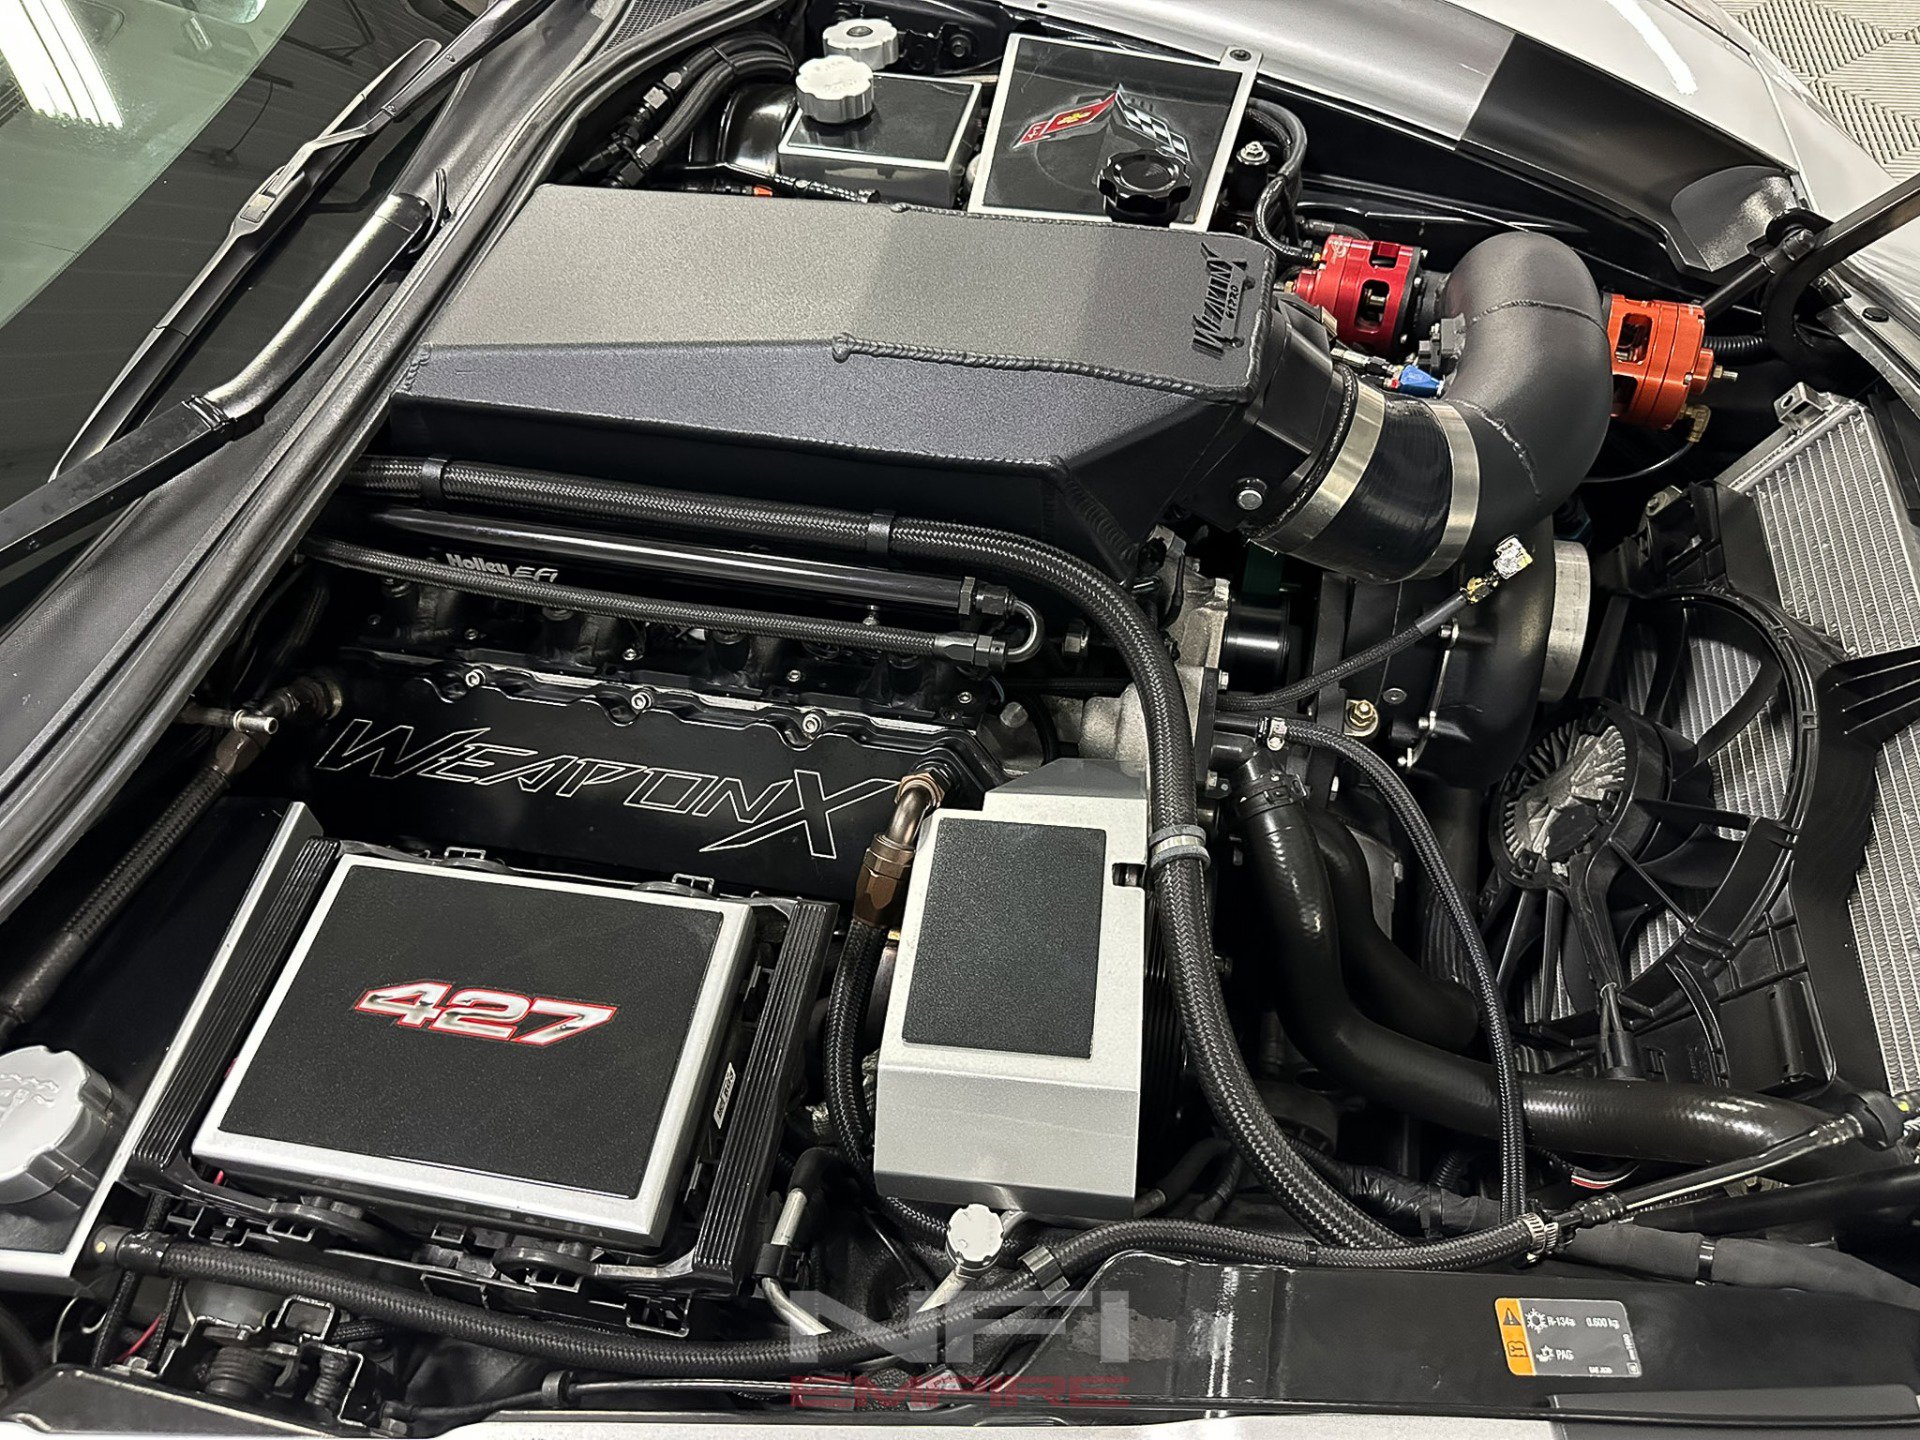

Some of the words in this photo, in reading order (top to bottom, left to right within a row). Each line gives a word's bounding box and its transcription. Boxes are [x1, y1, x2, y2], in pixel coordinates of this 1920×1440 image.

[445, 553, 510, 577] Holley
[354, 981, 618, 1047] 427
[1608, 1318, 1621, 1330] kg
[1555, 1349, 1575, 1361] PAG
